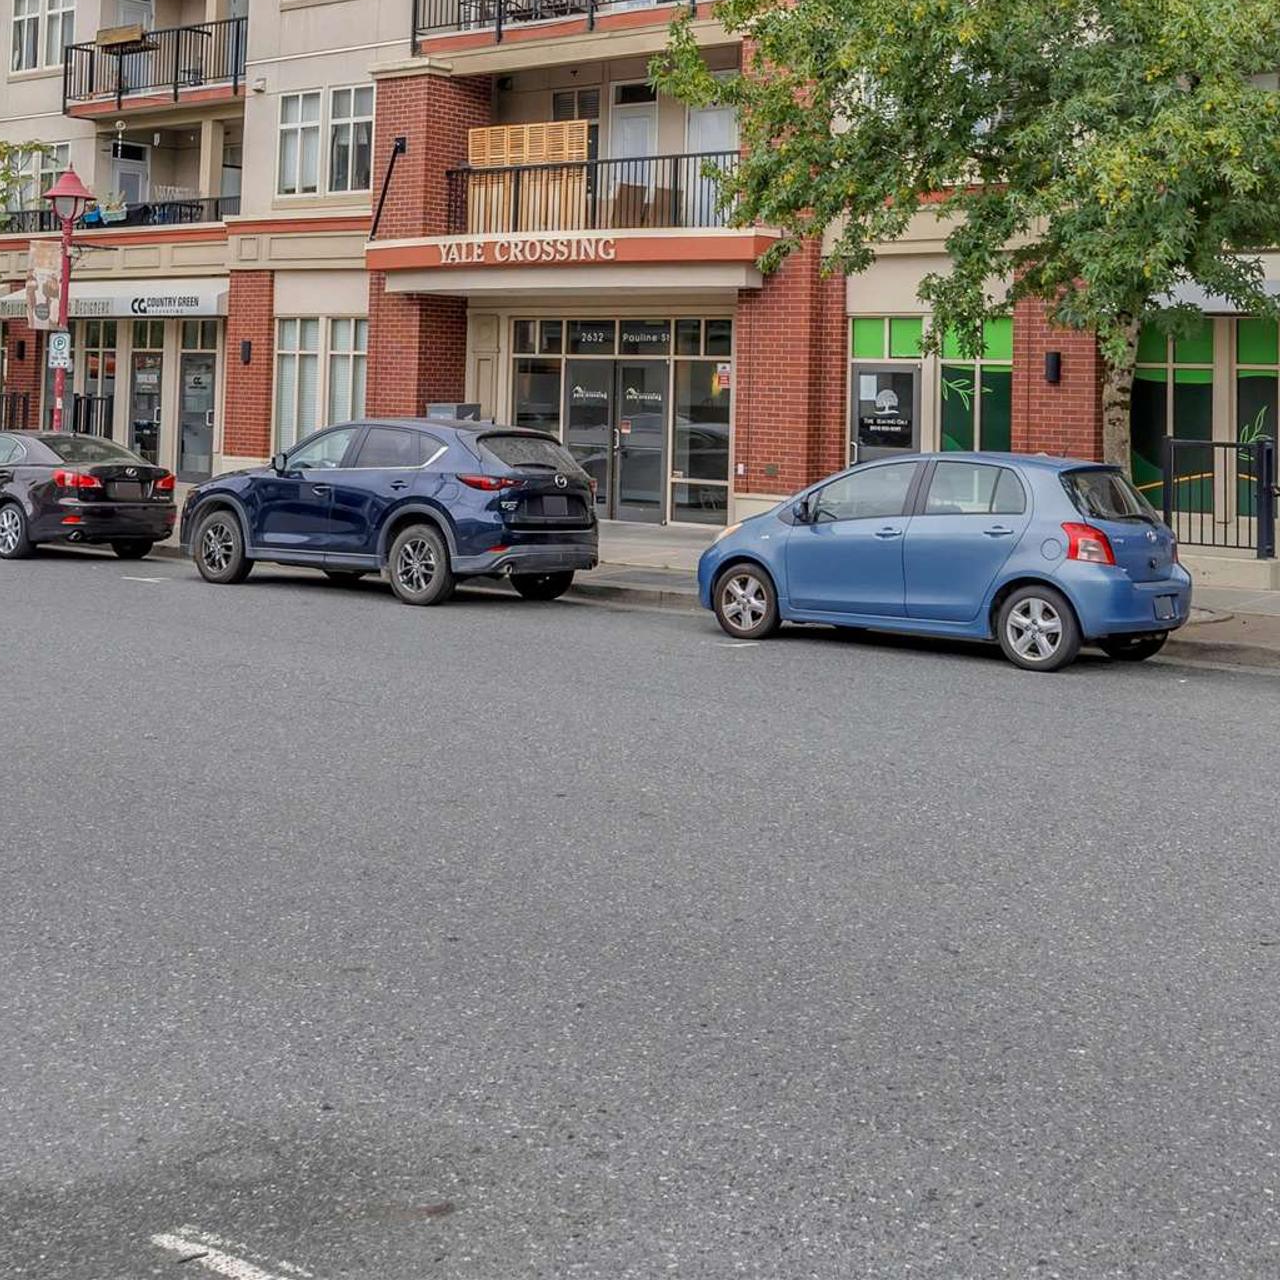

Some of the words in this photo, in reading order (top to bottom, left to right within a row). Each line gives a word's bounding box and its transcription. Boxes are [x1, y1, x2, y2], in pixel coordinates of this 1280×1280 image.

[438, 242, 485, 263] YALE
[495, 238, 616, 261] CROSSING
[147, 297, 177, 308] COUNTRY
[581, 332, 604, 342] 2632
[622, 333, 658, 342] Pauline
